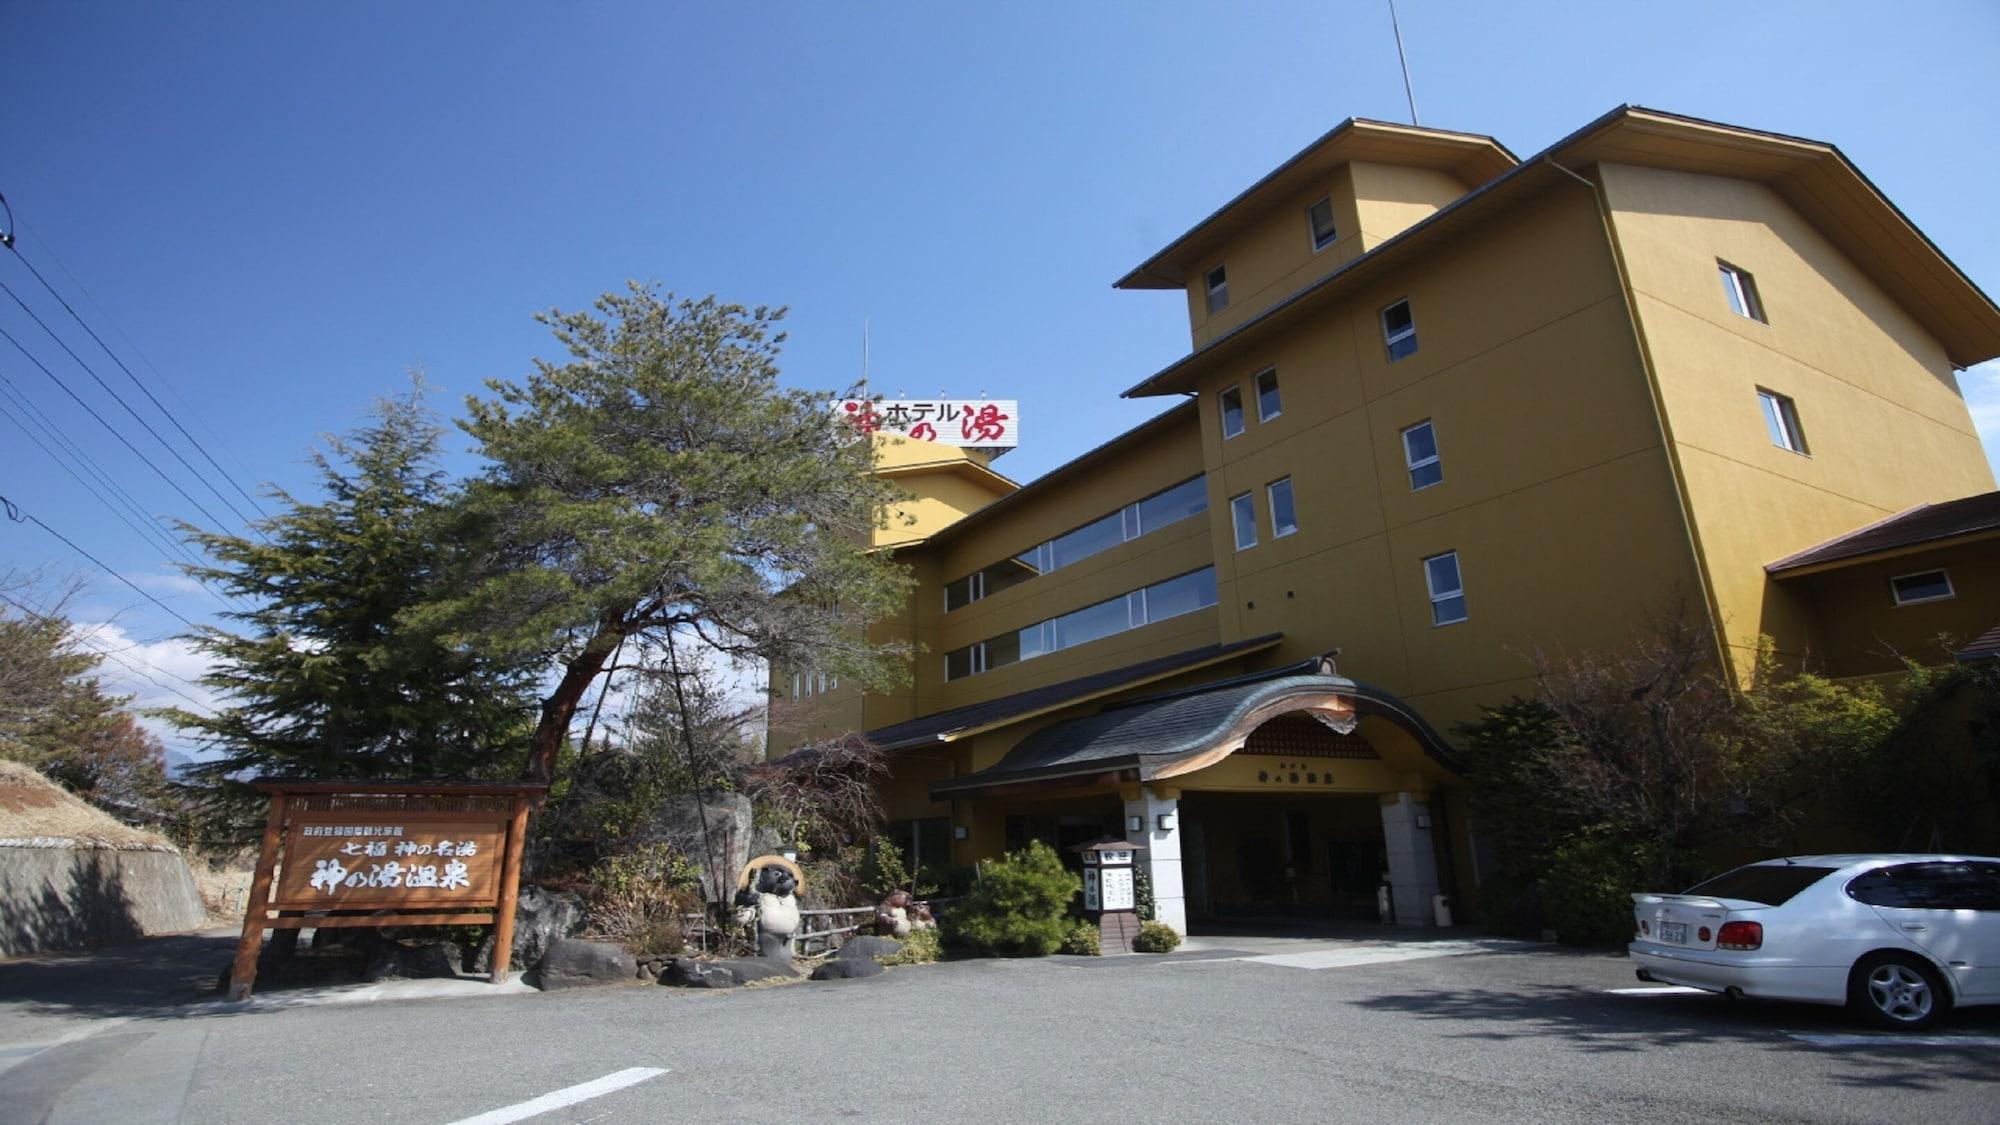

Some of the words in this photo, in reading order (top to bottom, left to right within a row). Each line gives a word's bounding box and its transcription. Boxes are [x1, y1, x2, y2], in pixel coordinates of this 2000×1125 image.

[886, 404, 961, 422] ホテル
[310, 858, 470, 895] 神の湯温泉
